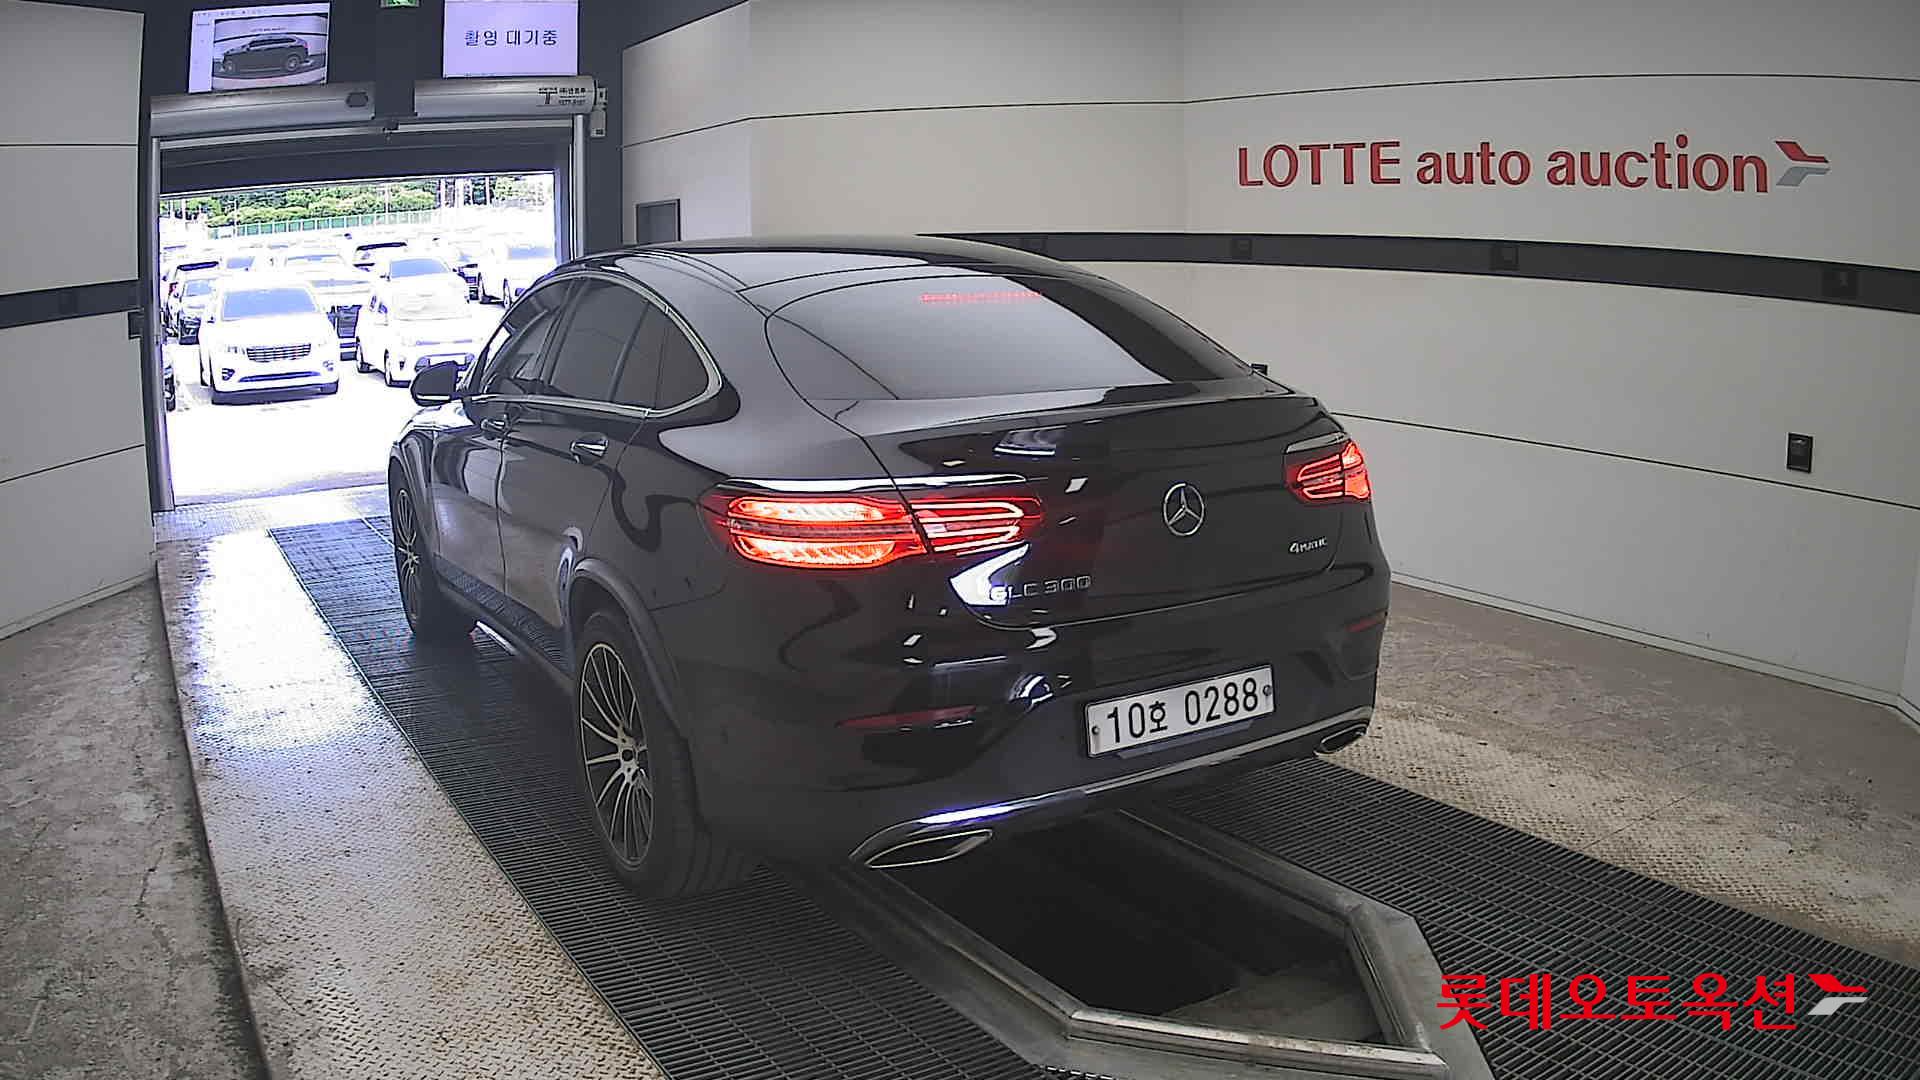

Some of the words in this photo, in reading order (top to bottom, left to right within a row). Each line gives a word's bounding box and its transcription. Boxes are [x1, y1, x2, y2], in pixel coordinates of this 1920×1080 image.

[465, 30, 498, 47] 촬영
[506, 29, 558, 46] 대기중
[1238, 141, 1401, 188] LOTTE
[1416, 141, 1531, 187] auto
[1546, 133, 1769, 194] auction
[989, 583, 1040, 602] GLC
[1044, 575, 1092, 595] 300
[1106, 699, 1169, 744] 10호
[1183, 676, 1259, 726] 0288
